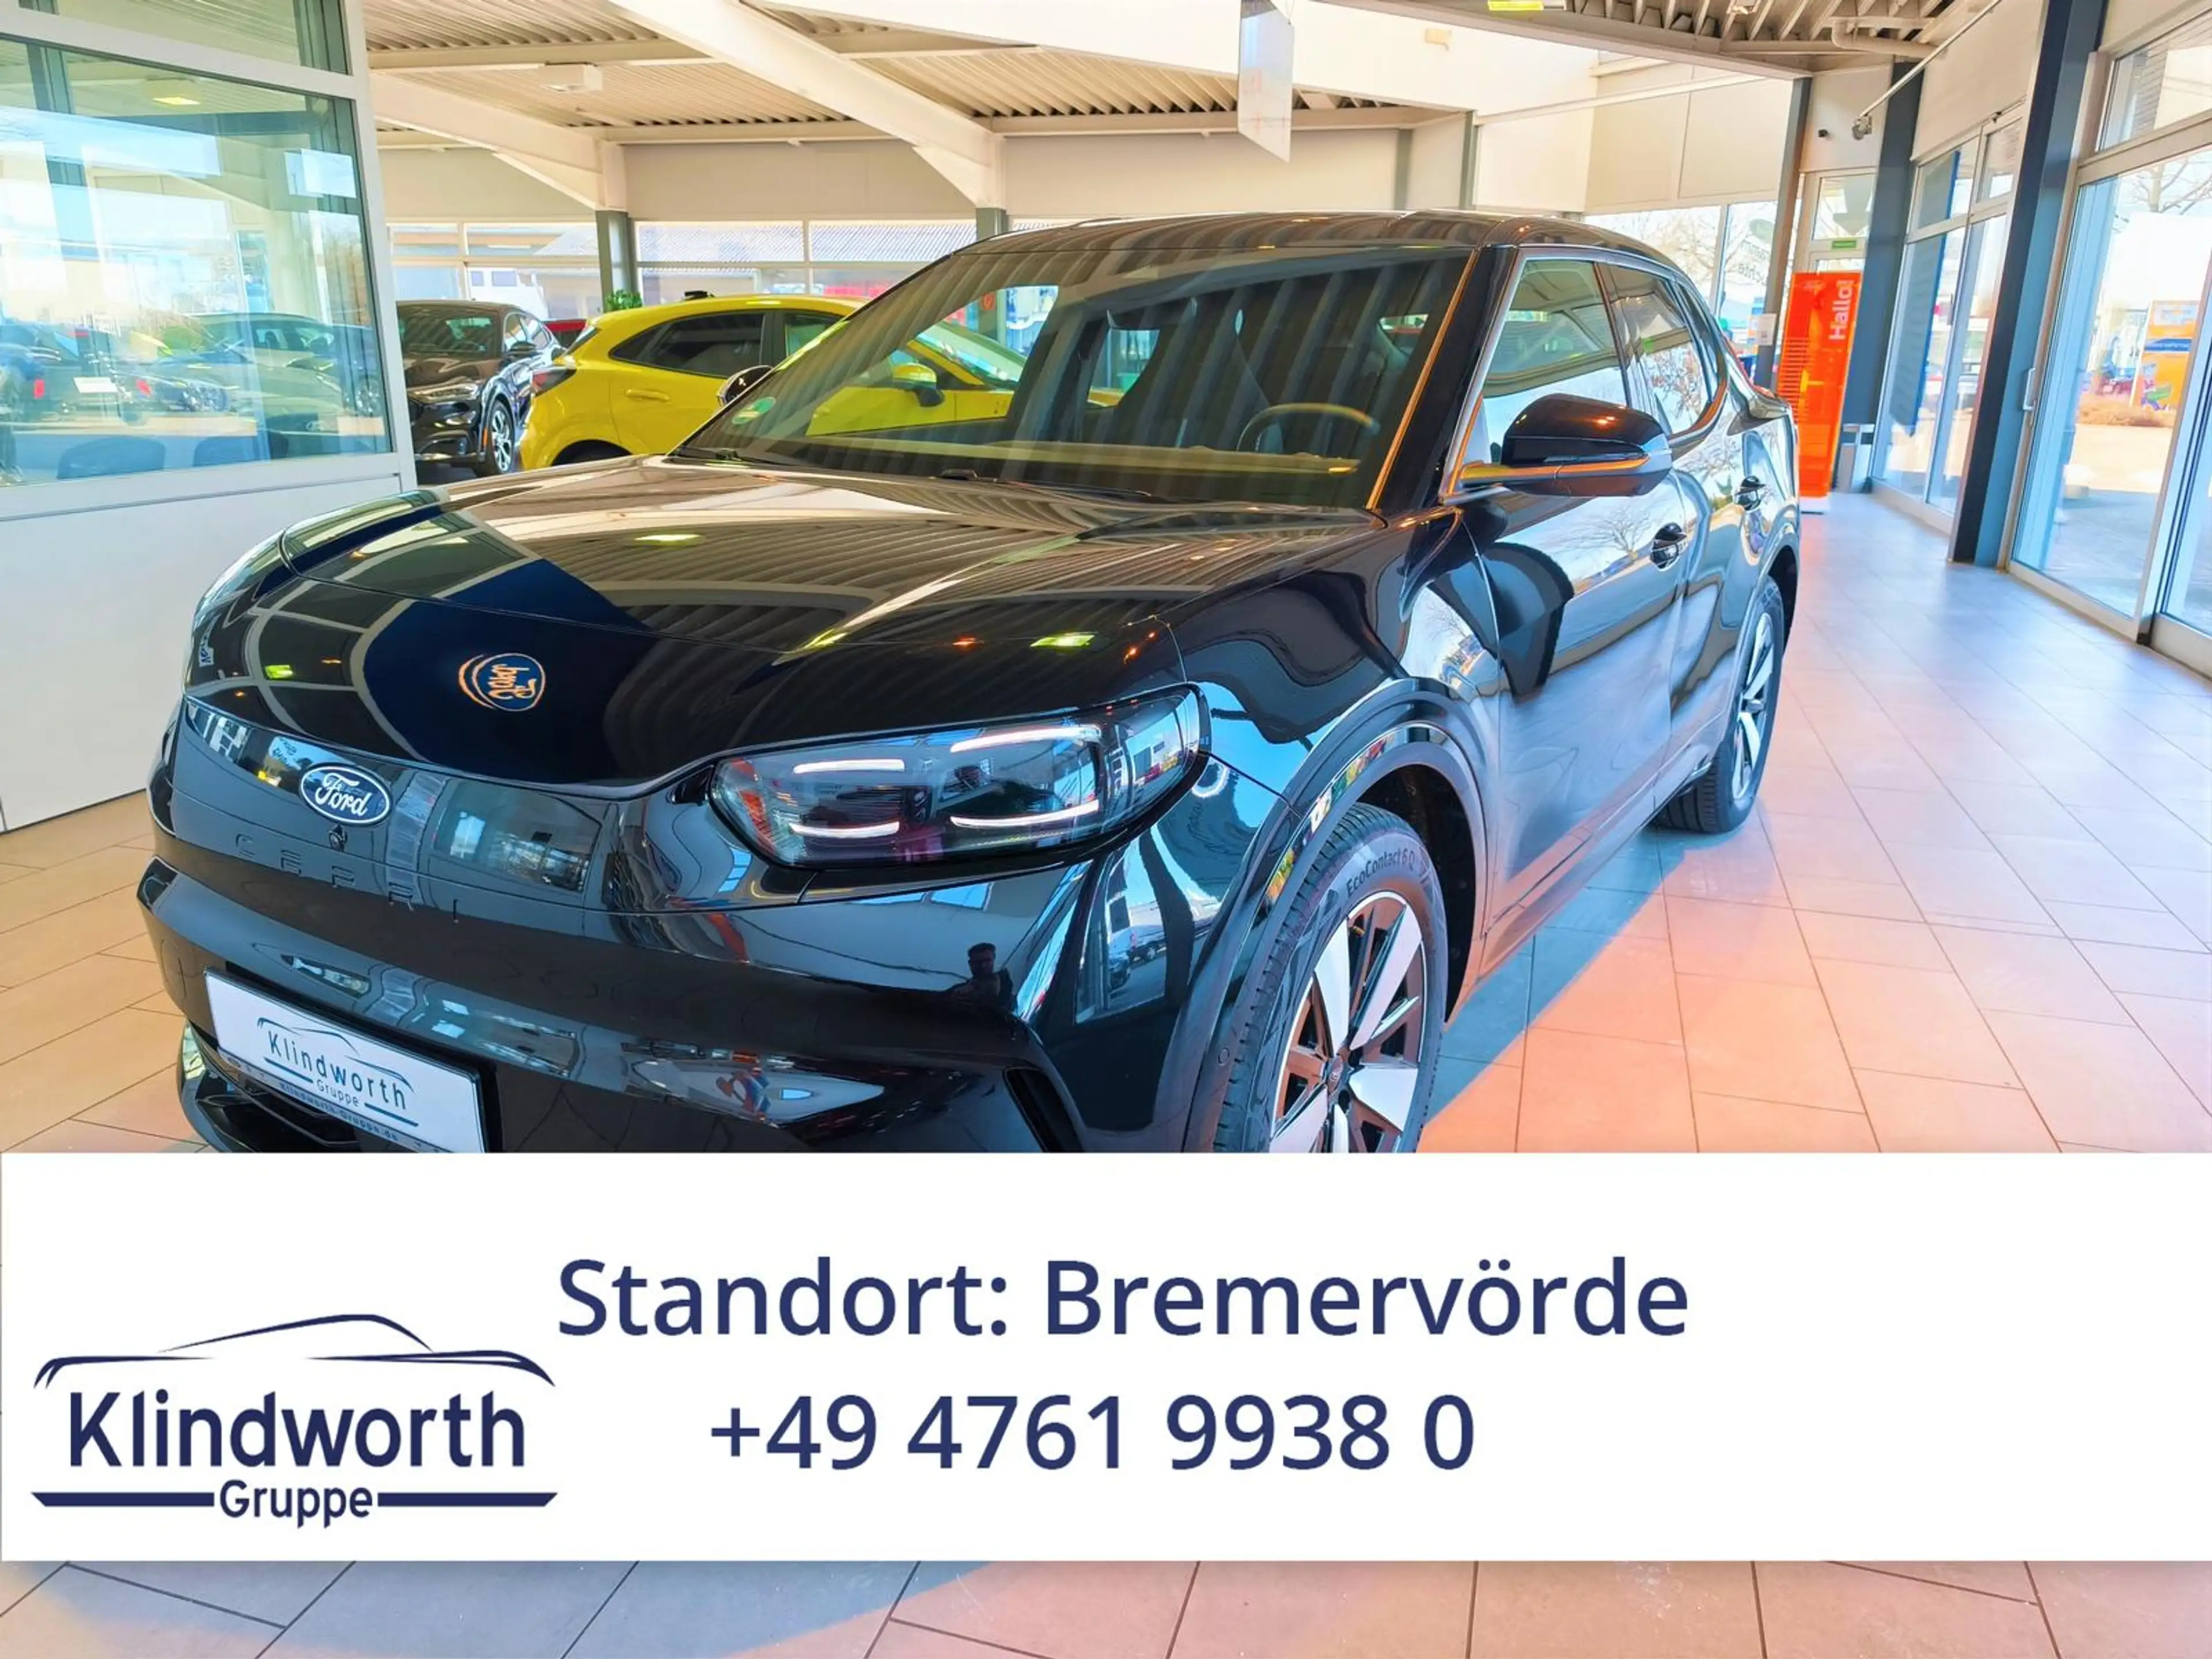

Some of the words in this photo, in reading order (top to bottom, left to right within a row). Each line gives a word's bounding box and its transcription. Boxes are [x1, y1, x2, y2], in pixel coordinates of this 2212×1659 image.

[1828, 280, 1854, 340] Hallo!
[315, 772, 373, 817] Ford
[1346, 846, 1401, 898] EcoContact
[267, 1030, 407, 1110] Klindworth
[316, 1079, 360, 1107] Gruppe
